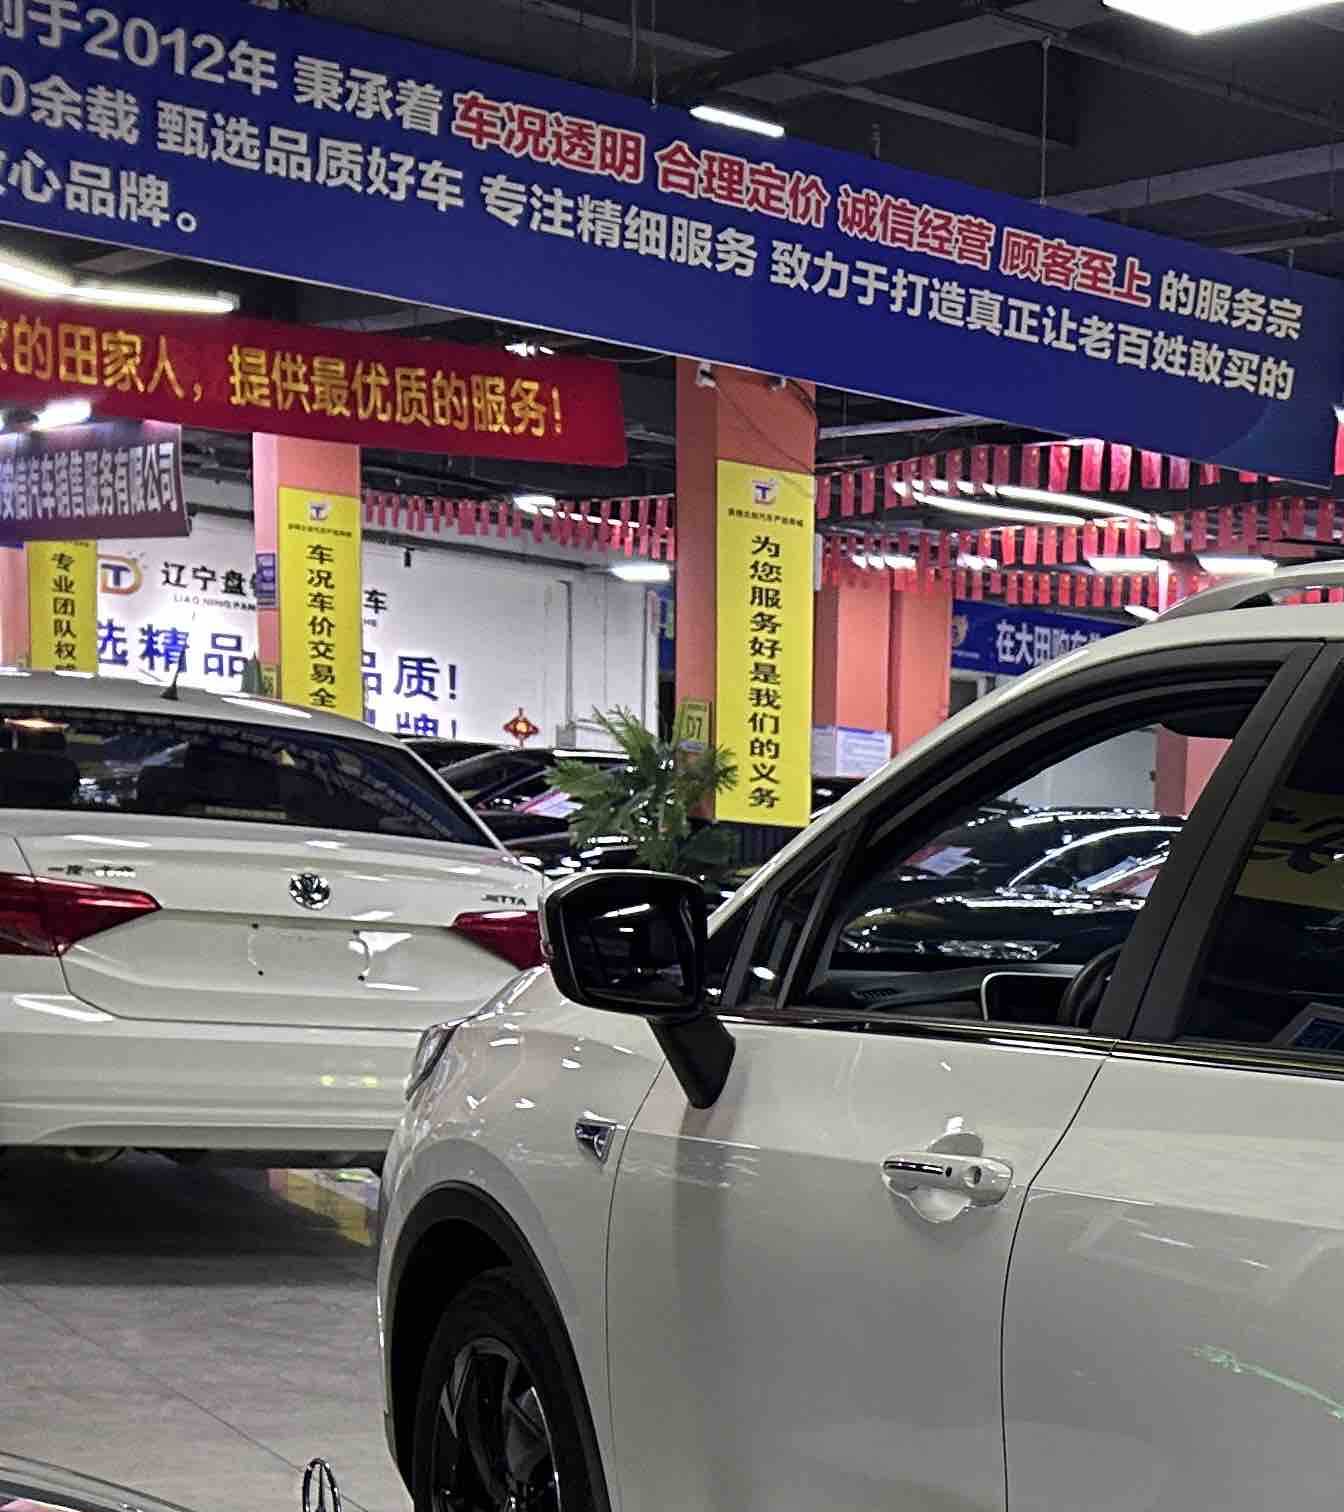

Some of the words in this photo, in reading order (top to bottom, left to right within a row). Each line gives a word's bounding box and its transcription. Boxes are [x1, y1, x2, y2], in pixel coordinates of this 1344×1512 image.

[0, 149, 198, 234] 心品牌。
[156, 99, 465, 213] 甄选品质好车
[479, 174, 757, 279] 专注精细服务
[769, 239, 1296, 401] 致力于打造真正让老百姓敢买的
[293, 55, 443, 136] 秉承着
[452, 90, 645, 184] 车况透明
[654, 141, 830, 228] 合理定价
[837, 183, 995, 271] 诚信经营
[1000, 227, 1152, 308] 顾客至上
[1159, 270, 1304, 341] 的服务宗
[0, 313, 563, 438] 的田家人，提供最优质的服务！
[161, 561, 257, 598] 辽宁盘
[306, 544, 337, 709] 车况车价交易全
[996, 618, 1102, 667] 在大田购
[748, 534, 782, 810] 为您服务好是我们的义务
